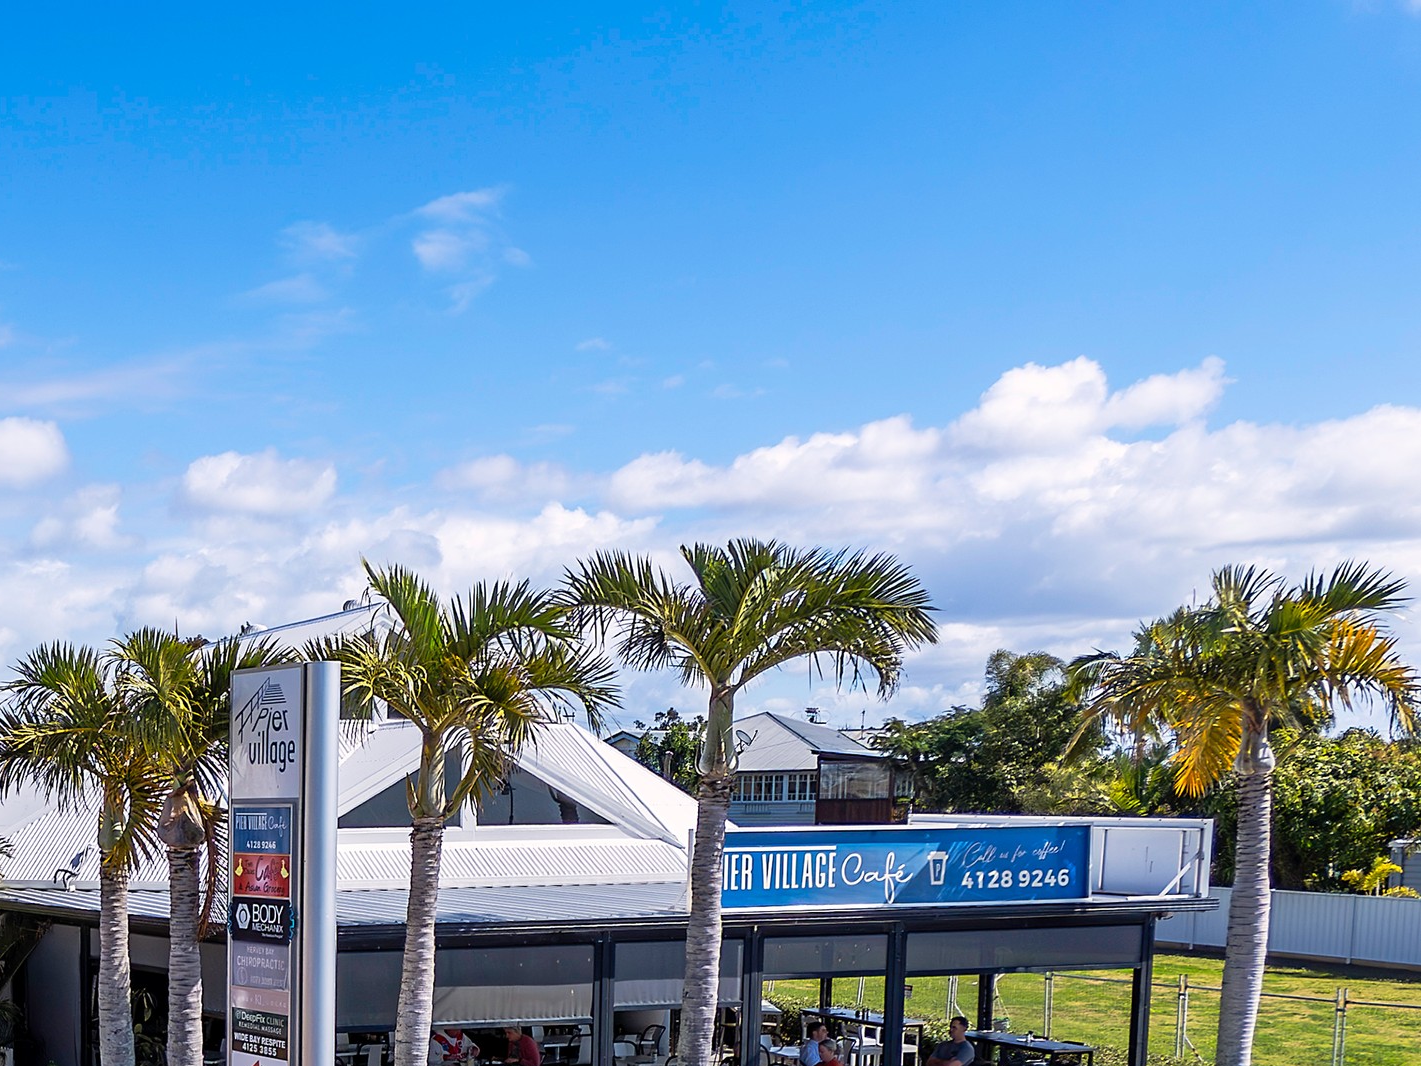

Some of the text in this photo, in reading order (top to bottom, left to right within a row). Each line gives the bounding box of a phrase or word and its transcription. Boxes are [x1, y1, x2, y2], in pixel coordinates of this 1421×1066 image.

[251, 707, 289, 732] Pier
[249, 730, 295, 773] village
[246, 840, 260, 849] 4128
[723, 851, 914, 904] IER VILLAGE Café
[961, 868, 1070, 889] 4128 9246
[252, 904, 284, 924] BODY
[236, 955, 285, 971] CHIROPRACTIC
[266, 1016, 285, 1028] CLINIC
[242, 1042, 258, 1053] 4125
[249, 1035, 261, 1044] BAY
[261, 1037, 286, 1049] RESPITE
